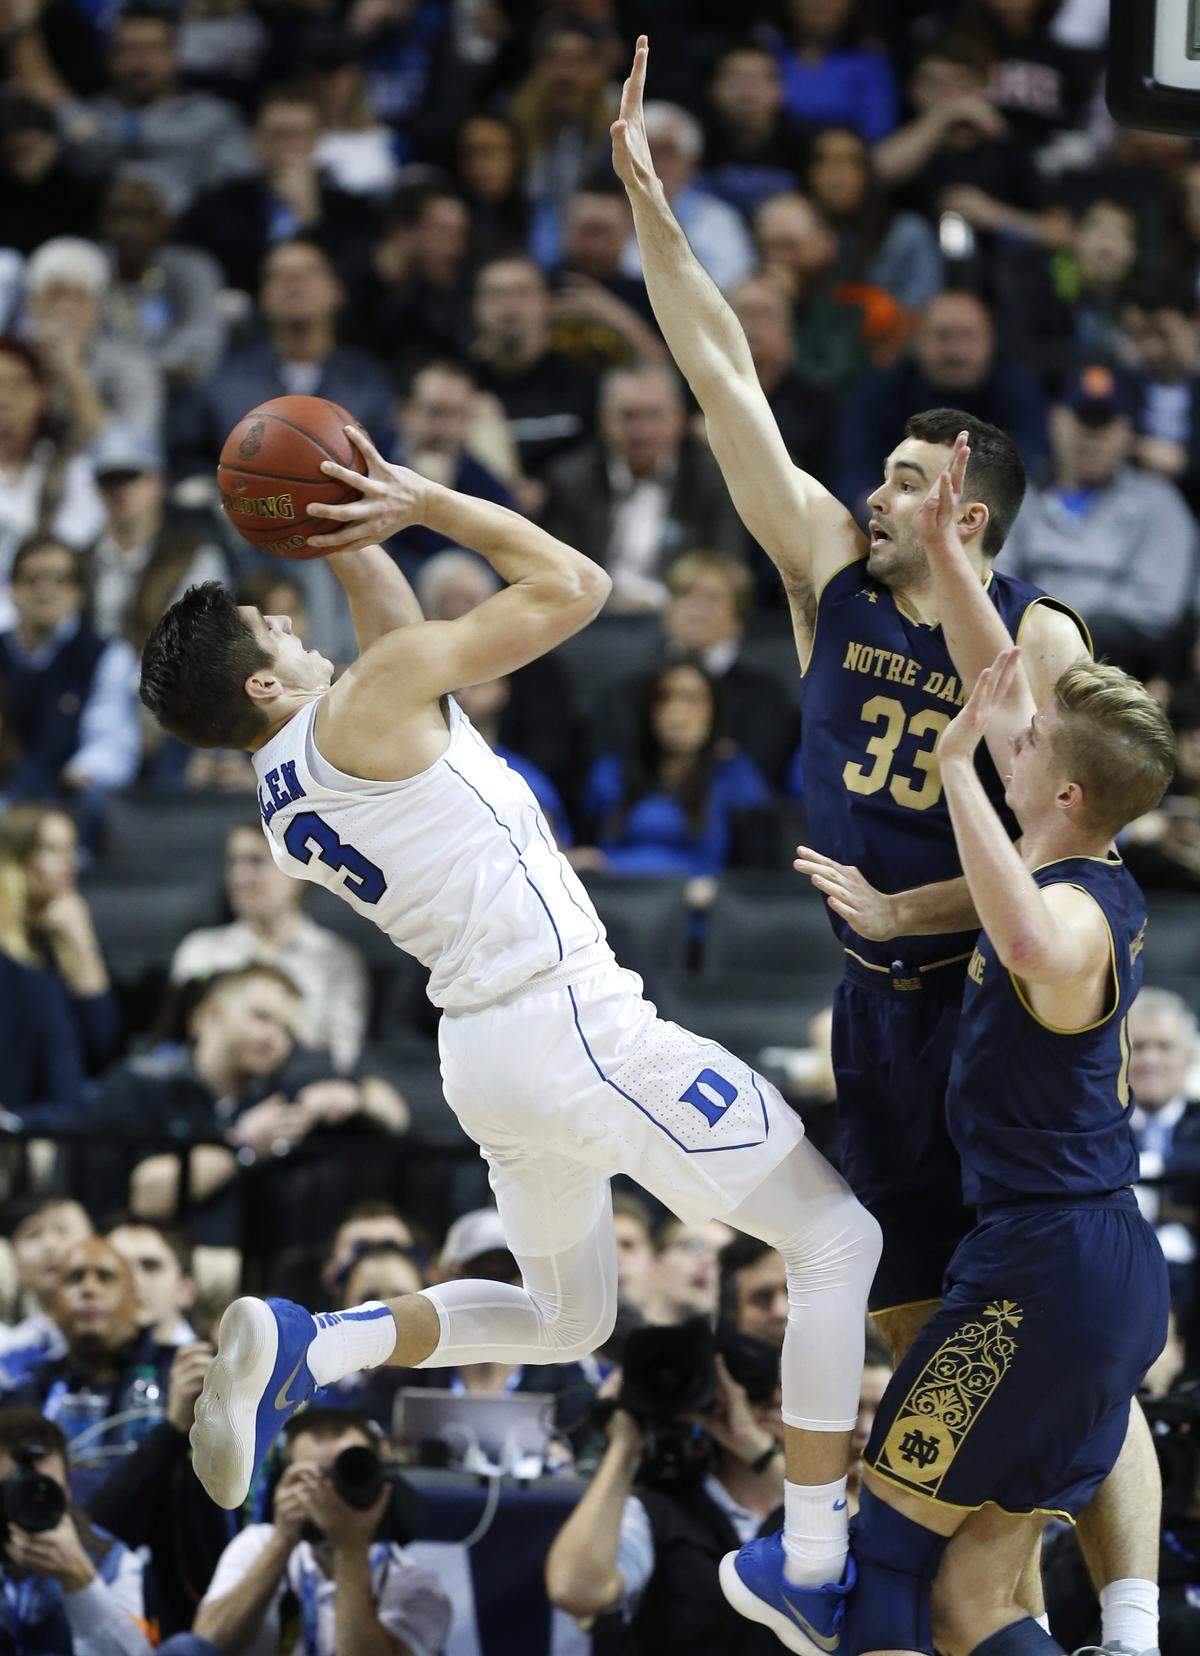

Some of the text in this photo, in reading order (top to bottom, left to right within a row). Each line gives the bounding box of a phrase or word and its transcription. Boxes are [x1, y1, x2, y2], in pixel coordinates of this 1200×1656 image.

[842, 641, 922, 687] NOTRE
[842, 694, 951, 811] 33
[259, 759, 307, 827] LEN
[283, 811, 388, 905] 3
[678, 1067, 739, 1129] D
